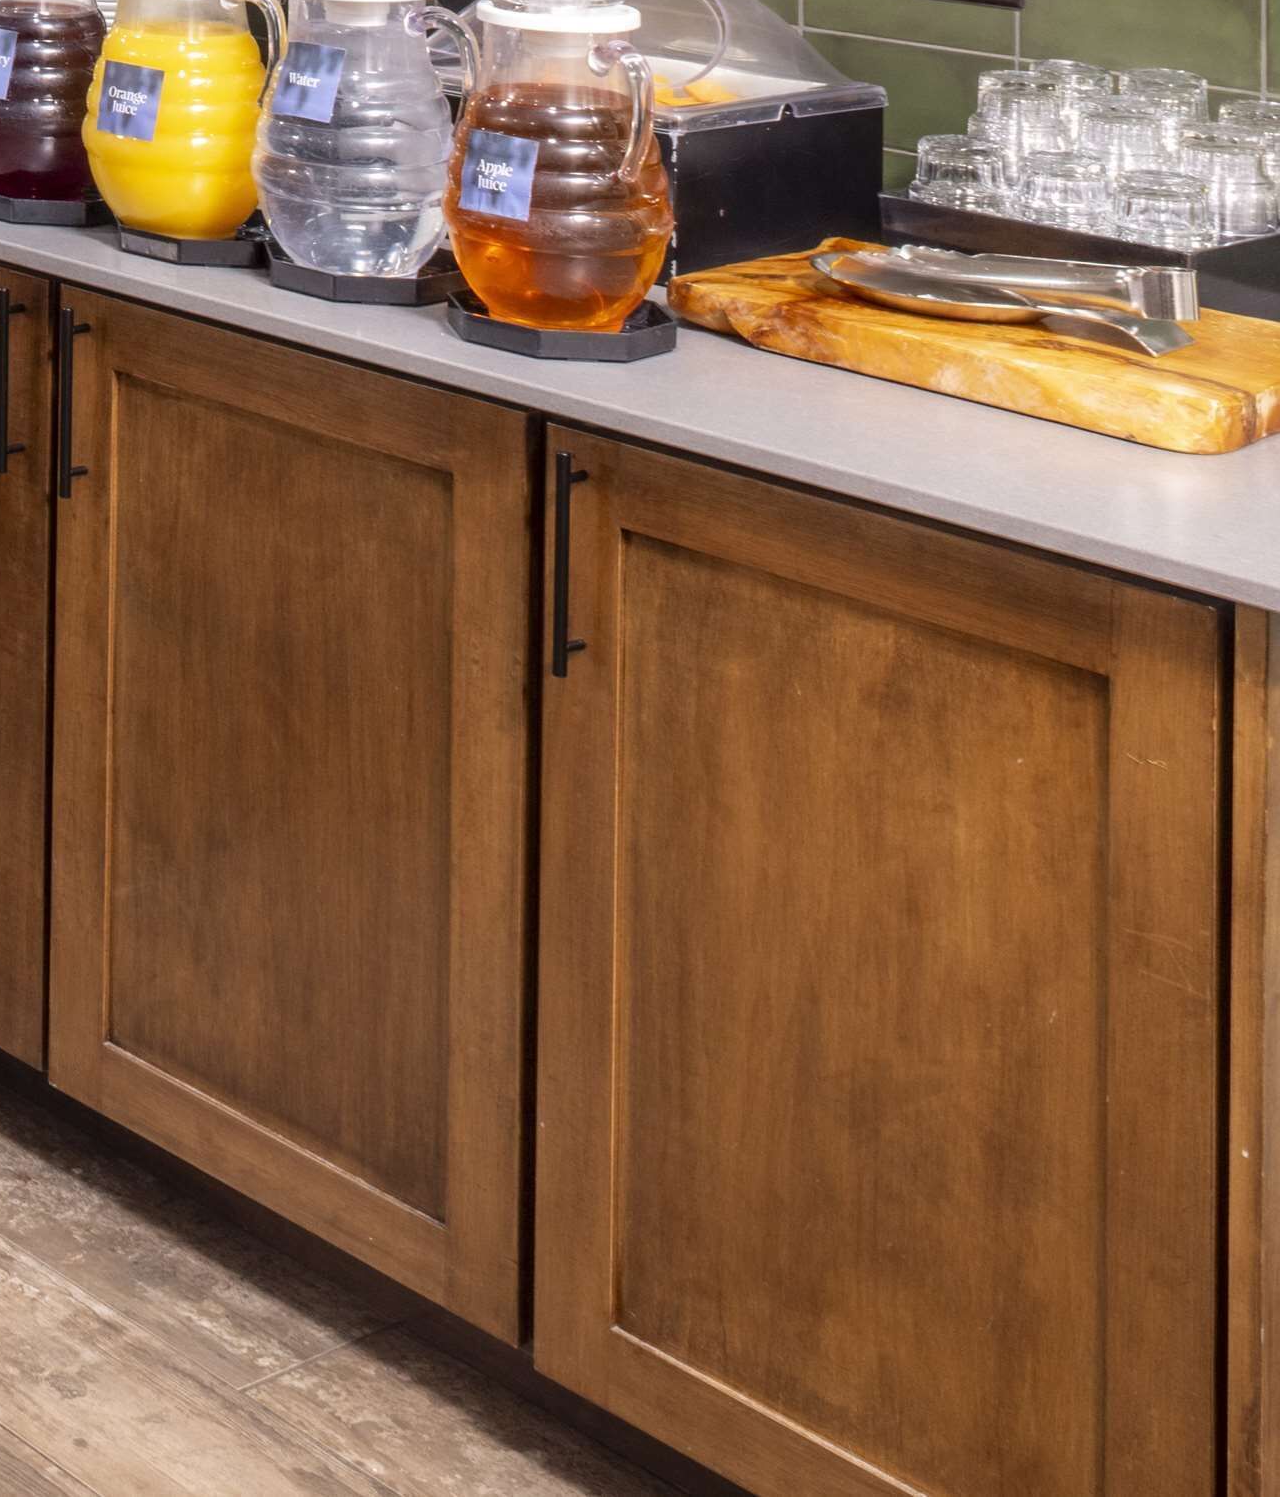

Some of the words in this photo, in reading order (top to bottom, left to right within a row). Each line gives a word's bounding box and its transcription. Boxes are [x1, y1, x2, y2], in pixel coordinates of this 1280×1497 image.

[289, 71, 321, 89] Water
[109, 85, 147, 105] Orange
[112, 100, 138, 116] Juice
[476, 158, 514, 178] Apple
[478, 174, 508, 192] Juice
